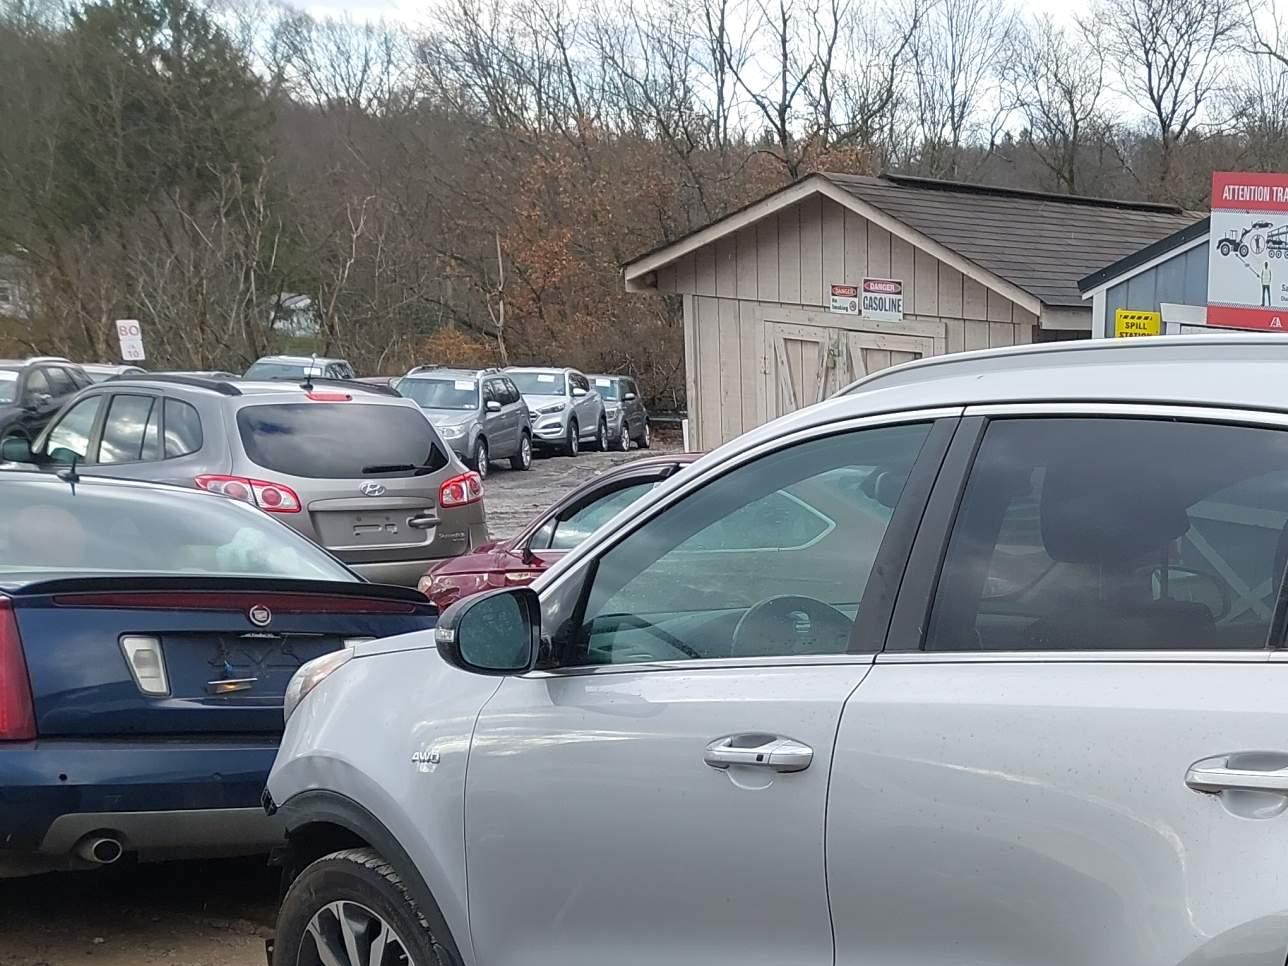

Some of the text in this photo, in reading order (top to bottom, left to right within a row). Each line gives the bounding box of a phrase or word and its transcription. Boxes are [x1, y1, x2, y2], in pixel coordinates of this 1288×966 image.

[1222, 185, 1270, 201] ATTENTION
[869, 282, 896, 291] DANGER
[863, 296, 902, 313] GASOLINE
[1125, 322, 1148, 330] SPILL
